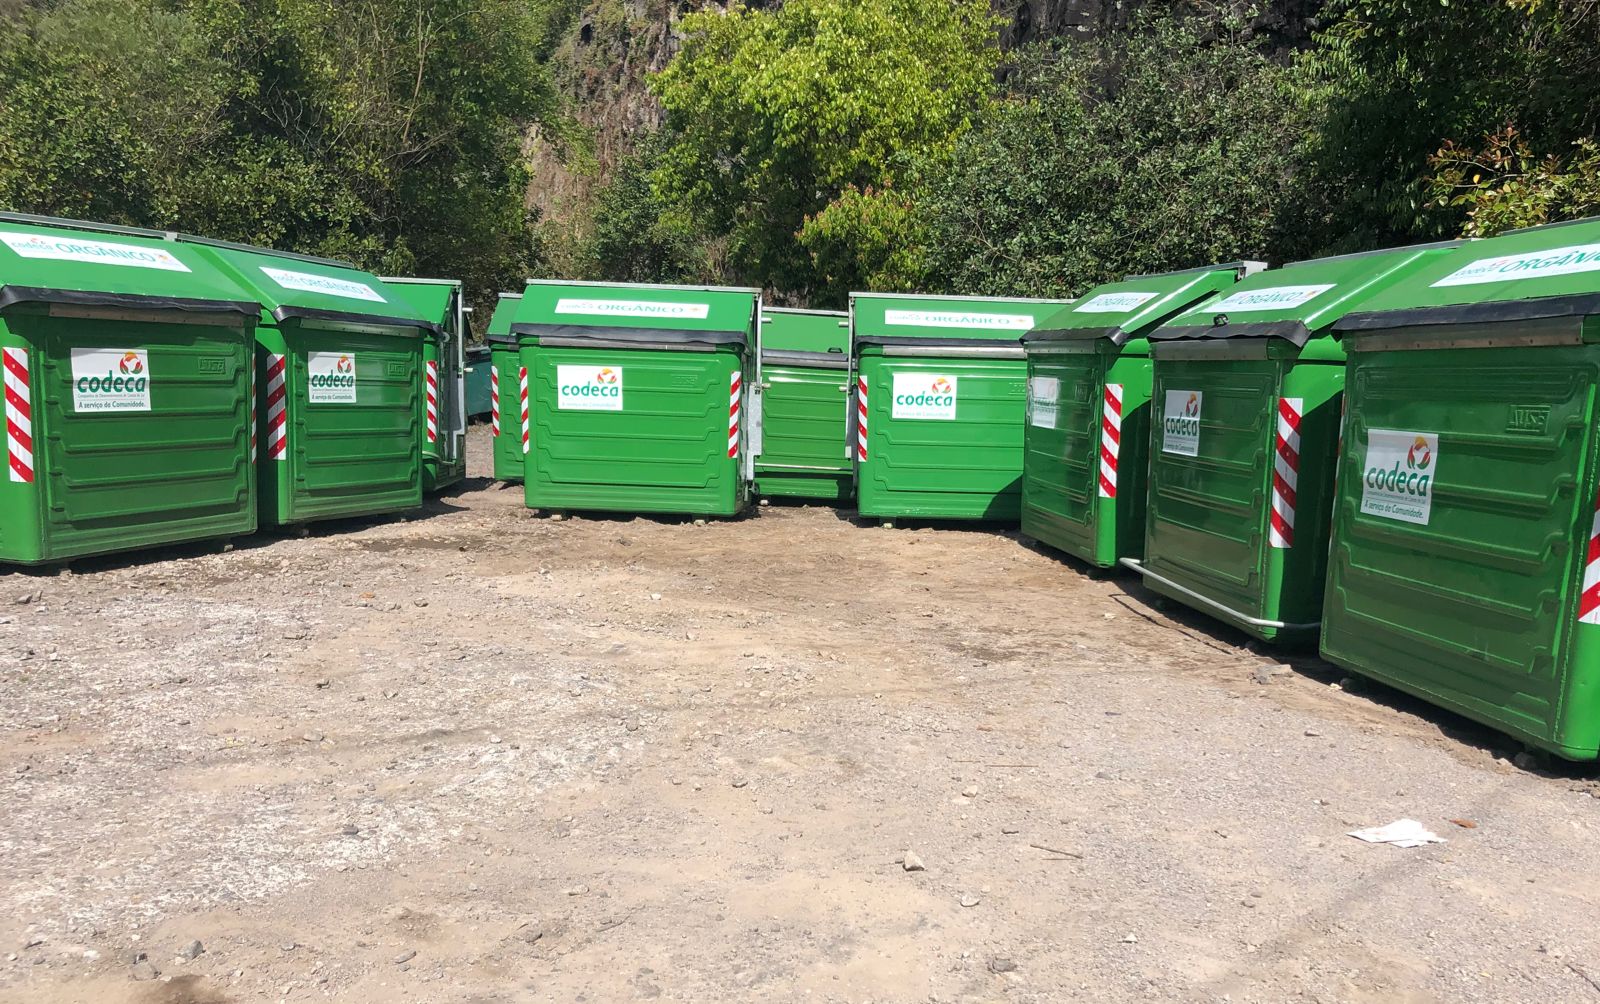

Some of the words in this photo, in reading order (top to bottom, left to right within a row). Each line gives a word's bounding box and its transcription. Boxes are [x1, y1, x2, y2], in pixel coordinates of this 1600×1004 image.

[55, 242, 157, 262] ORGÂNICO
[1499, 249, 1600, 273] ORGÂNI
[597, 303, 684, 314] ORGÂNICO
[925, 314, 1011, 325] ORGÂNICO
[77, 369, 147, 393] codeca
[311, 369, 353, 388] codeca
[561, 381, 619, 398] codeca
[896, 390, 953, 407] codeca
[1165, 412, 1198, 437] codeca
[1366, 461, 1430, 497] codeca
